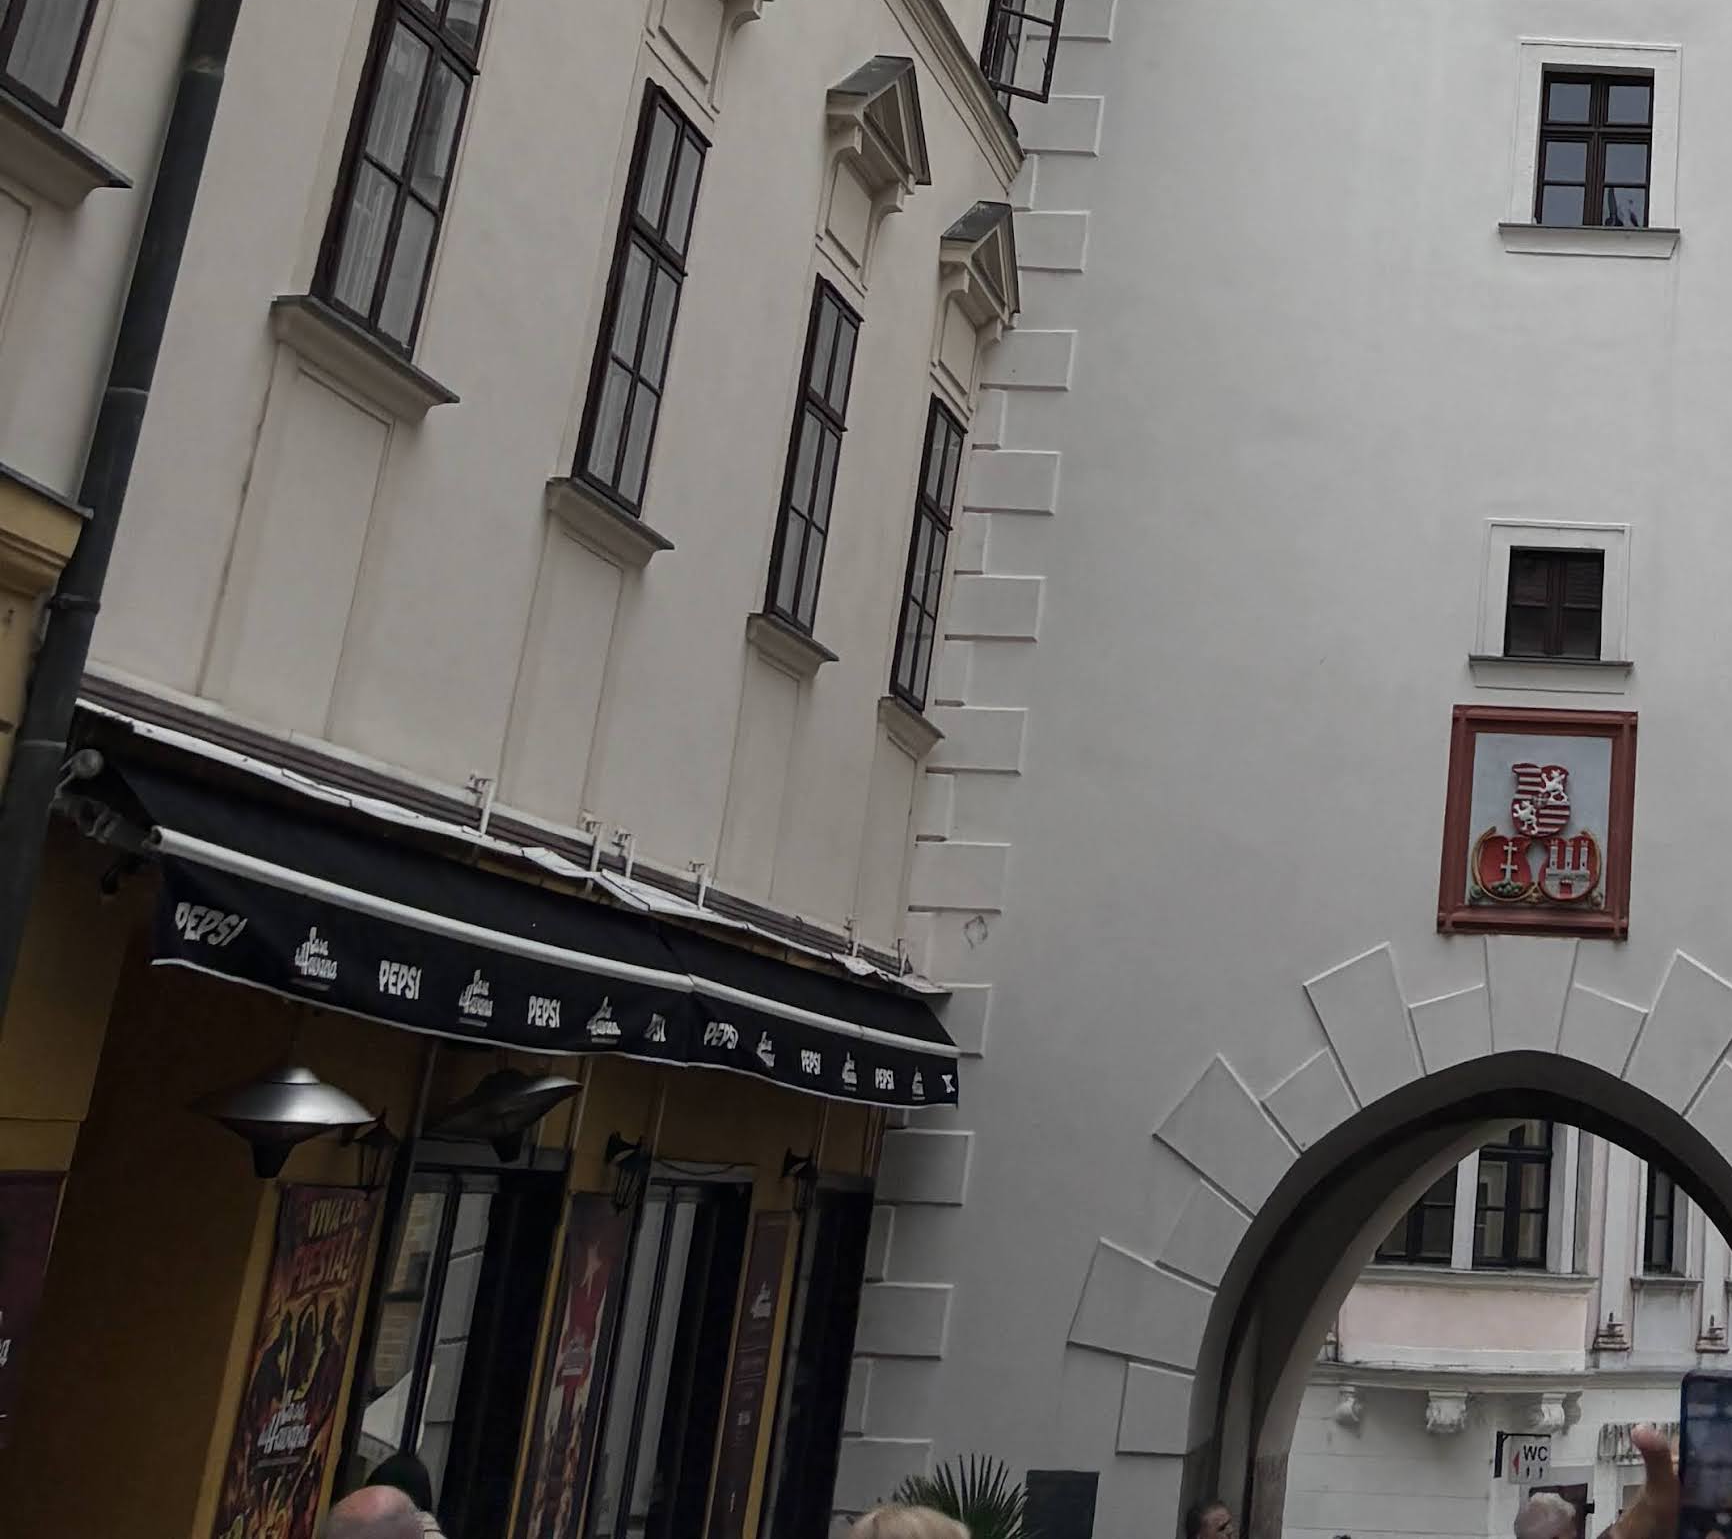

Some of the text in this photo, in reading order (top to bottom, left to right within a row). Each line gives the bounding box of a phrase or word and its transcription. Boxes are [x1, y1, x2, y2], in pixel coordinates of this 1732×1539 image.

[378, 959, 422, 1000] PEPSI
[527, 995, 561, 1028] PEPSI
[800, 1048, 822, 1076] PEPSI
[875, 1067, 895, 1091] PEPSI
[1523, 1445, 1548, 1461] WC
